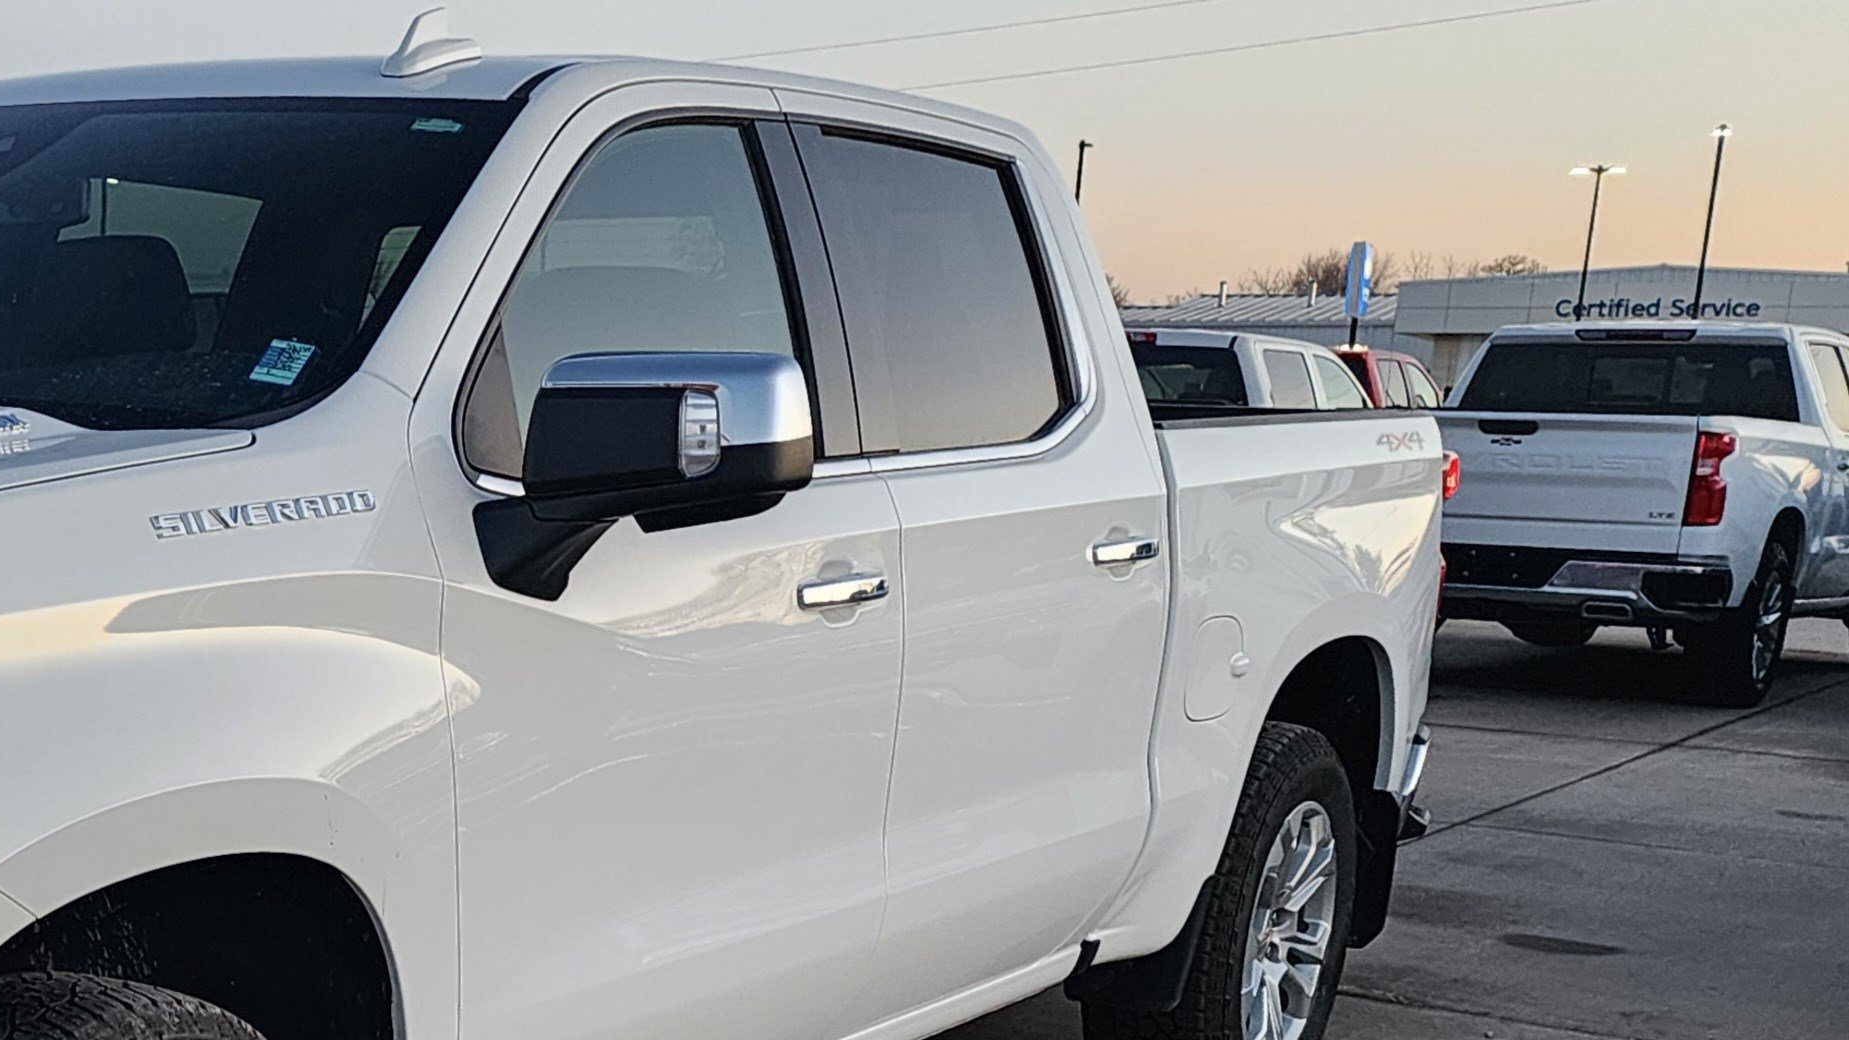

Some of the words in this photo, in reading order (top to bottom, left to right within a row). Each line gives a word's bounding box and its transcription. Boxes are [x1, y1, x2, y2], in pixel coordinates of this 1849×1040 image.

[1555, 298, 1662, 318] Certified
[1669, 298, 1761, 318] Service
[149, 489, 376, 539] SILVERADO
